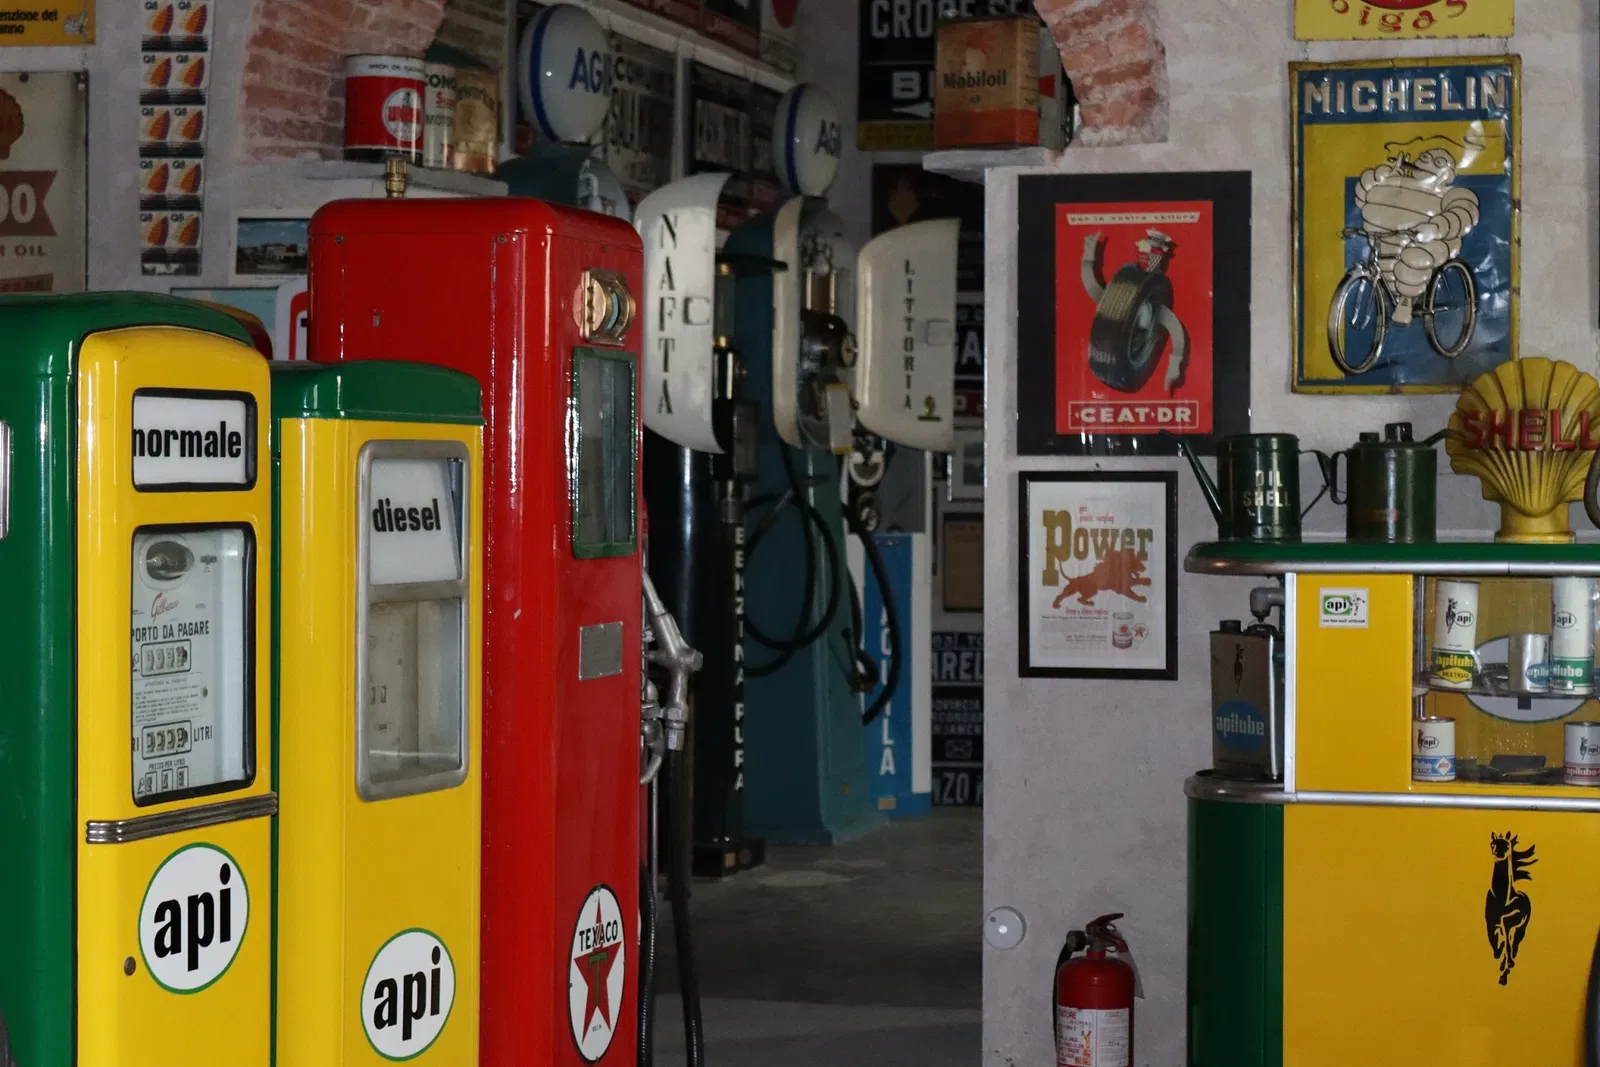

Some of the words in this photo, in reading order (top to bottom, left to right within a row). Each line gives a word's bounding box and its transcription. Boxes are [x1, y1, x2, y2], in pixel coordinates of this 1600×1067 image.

[944, 69, 1008, 89] Mobiloil
[1304, 76, 1506, 115] MICHELIN
[658, 213, 679, 414] NAFTA
[1462, 408, 1600, 452] SHELL
[1255, 469, 1283, 488] OIL
[1242, 489, 1292, 508] SHELL
[372, 497, 441, 533] diesel
[1326, 597, 1347, 612] api
[162, 623, 175, 639] DA
[177, 619, 210, 637] PAGARE
[1456, 613, 1473, 624] api
[1556, 615, 1572, 626] api
[193, 725, 213, 743] LITRI
[1215, 712, 1265, 737] apilube
[153, 862, 232, 972] api
[579, 919, 619, 953] TEXACO
[373, 946, 441, 1041] api
